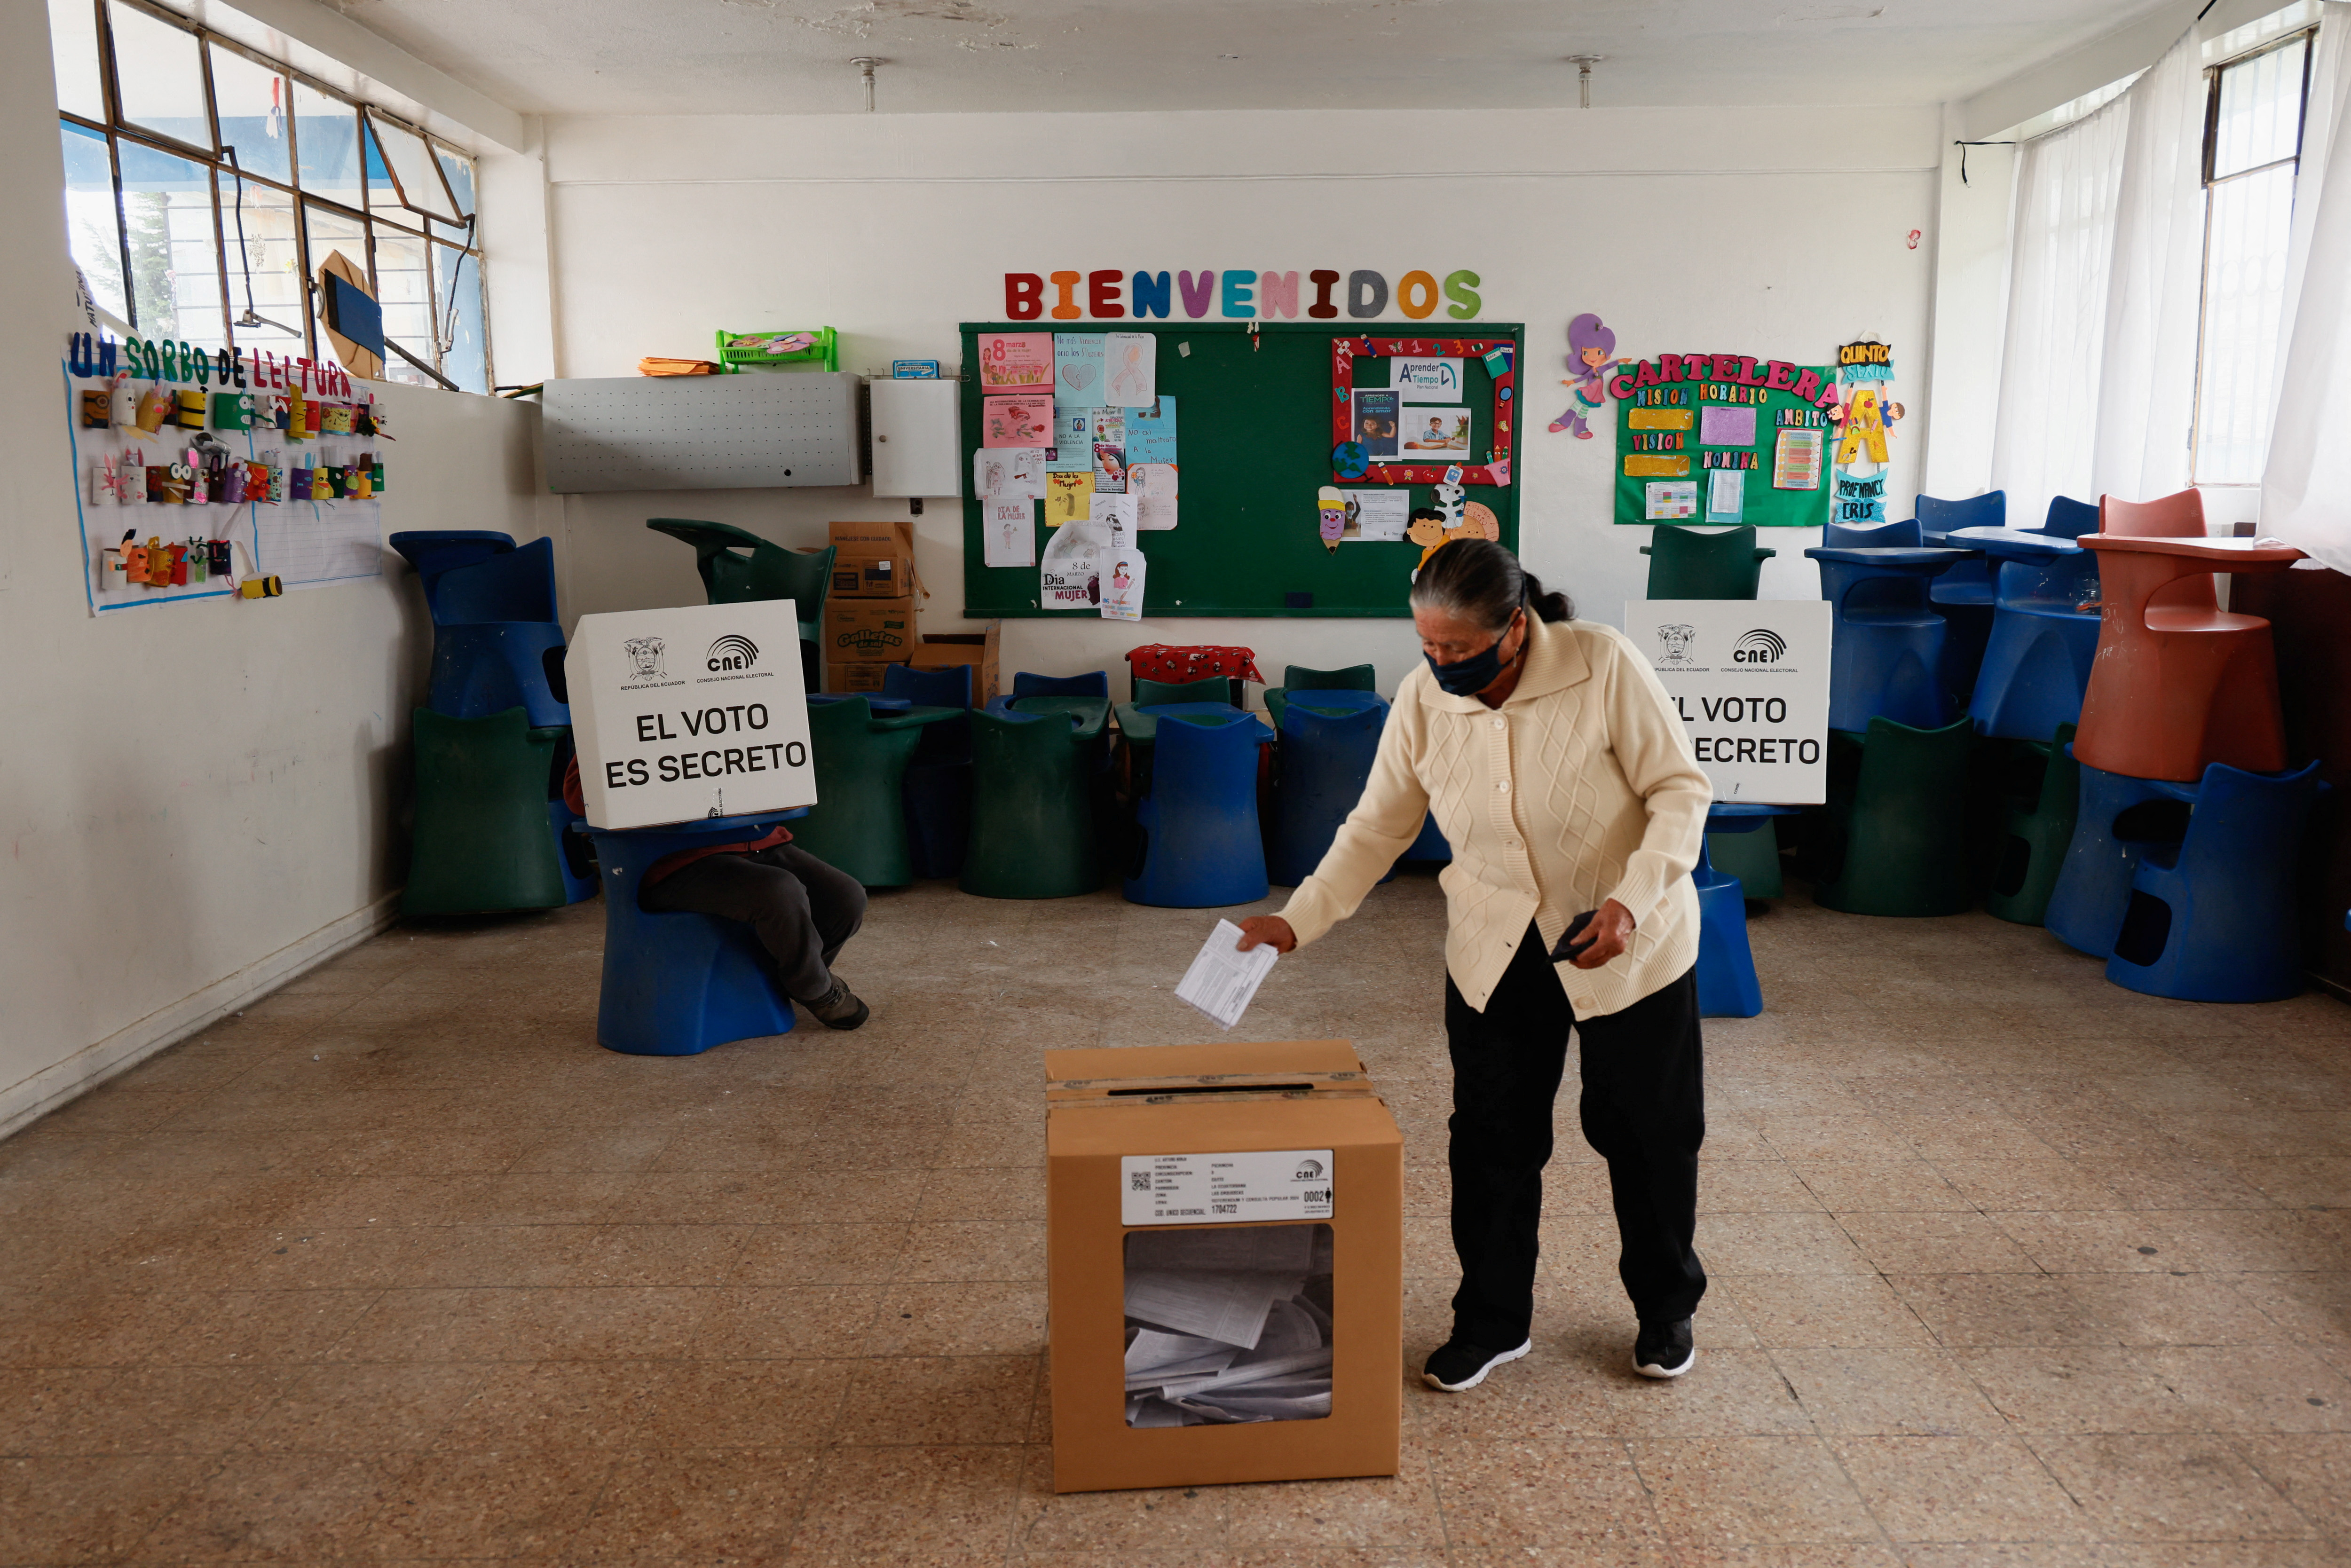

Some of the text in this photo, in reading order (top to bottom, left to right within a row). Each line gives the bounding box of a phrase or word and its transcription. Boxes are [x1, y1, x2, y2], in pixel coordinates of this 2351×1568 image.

[1005, 269, 1481, 320] BIENVENIDOS
[1057, 335, 1065, 344] No
[1411, 339, 1464, 356] 1 2 3
[993, 339, 1006, 361] 8
[1840, 345, 1889, 364] QUINTO
[71, 332, 116, 378] UN
[126, 336, 209, 385] SORBO
[219, 347, 246, 388] DE
[1336, 356, 1351, 374] A
[1399, 363, 1439, 383] Aprender
[1412, 375, 1439, 385] Tiempo
[1609, 353, 1839, 409] CARTELERA
[1334, 386, 1349, 403] B
[1636, 387, 1689, 407] MISION
[1699, 383, 1767, 404] HORARIO
[1336, 416, 1349, 430] C
[1775, 408, 1828, 428] AMBITO
[1837, 390, 1890, 463] A
[1094, 443, 1100, 453] 8
[1633, 432, 1684, 451] VISION
[1703, 451, 1759, 470] NOMINA
[1059, 480, 1077, 490] Mujer
[1843, 502, 1874, 520] CRIS
[1080, 561, 1091, 570] de
[1043, 574, 1065, 585] Dia
[1055, 590, 1088, 602] MUJER
[837, 629, 903, 647] Galletas
[707, 655, 742, 672] CNE
[1733, 649, 1767, 663] CNE
[1701, 697, 1786, 723] VOTO
[636, 703, 768, 742] EL VOTO
[1689, 737, 1820, 765] ECRETO
[606, 741, 807, 788] ES SECRETO
[1304, 1191, 1325, 1203] 0002
[1211, 1204, 1238, 1214] 1704722
